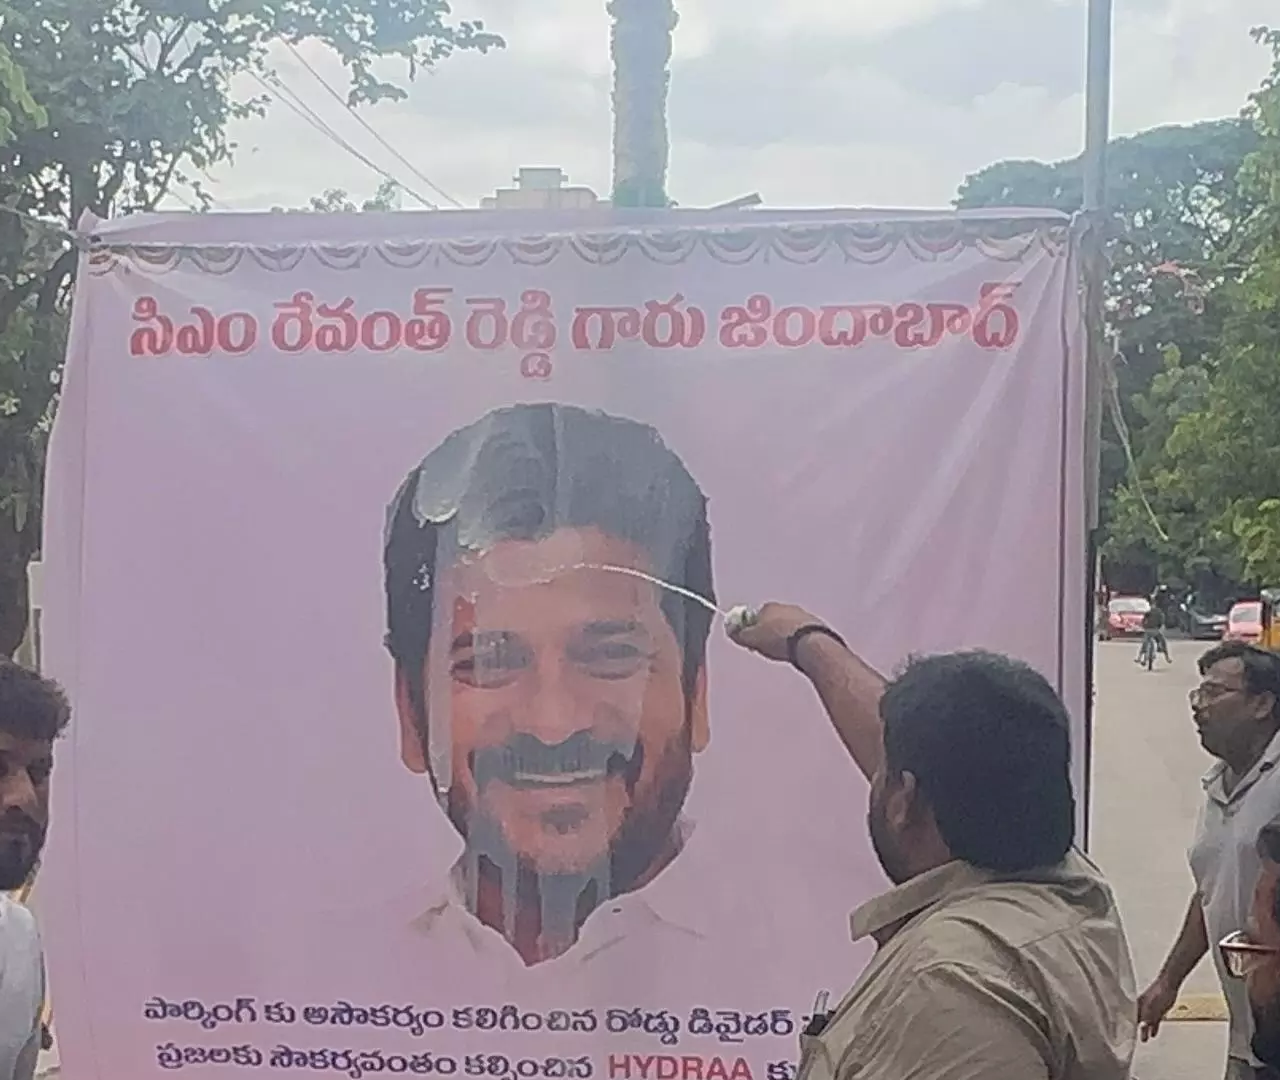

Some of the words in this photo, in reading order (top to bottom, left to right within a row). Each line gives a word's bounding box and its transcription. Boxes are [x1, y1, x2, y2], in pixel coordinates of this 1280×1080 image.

[271, 287, 454, 353] రేవంత్
[465, 288, 557, 379] రెడ్డి
[572, 292, 706, 350] గారు
[719, 282, 1022, 350] జిందాబాద్
[144, 996, 257, 1029] పార్కింగ్
[264, 1001, 296, 1025] కు
[303, 1000, 444, 1037] అసౌకర్యం
[452, 1005, 598, 1032] కలిగించిన
[606, 1008, 680, 1045] రోడ్డు
[688, 1007, 794, 1043] డివైడర్
[156, 1042, 263, 1070] ప్రజలకు
[270, 1044, 457, 1079] సౌకర్యవంతం
